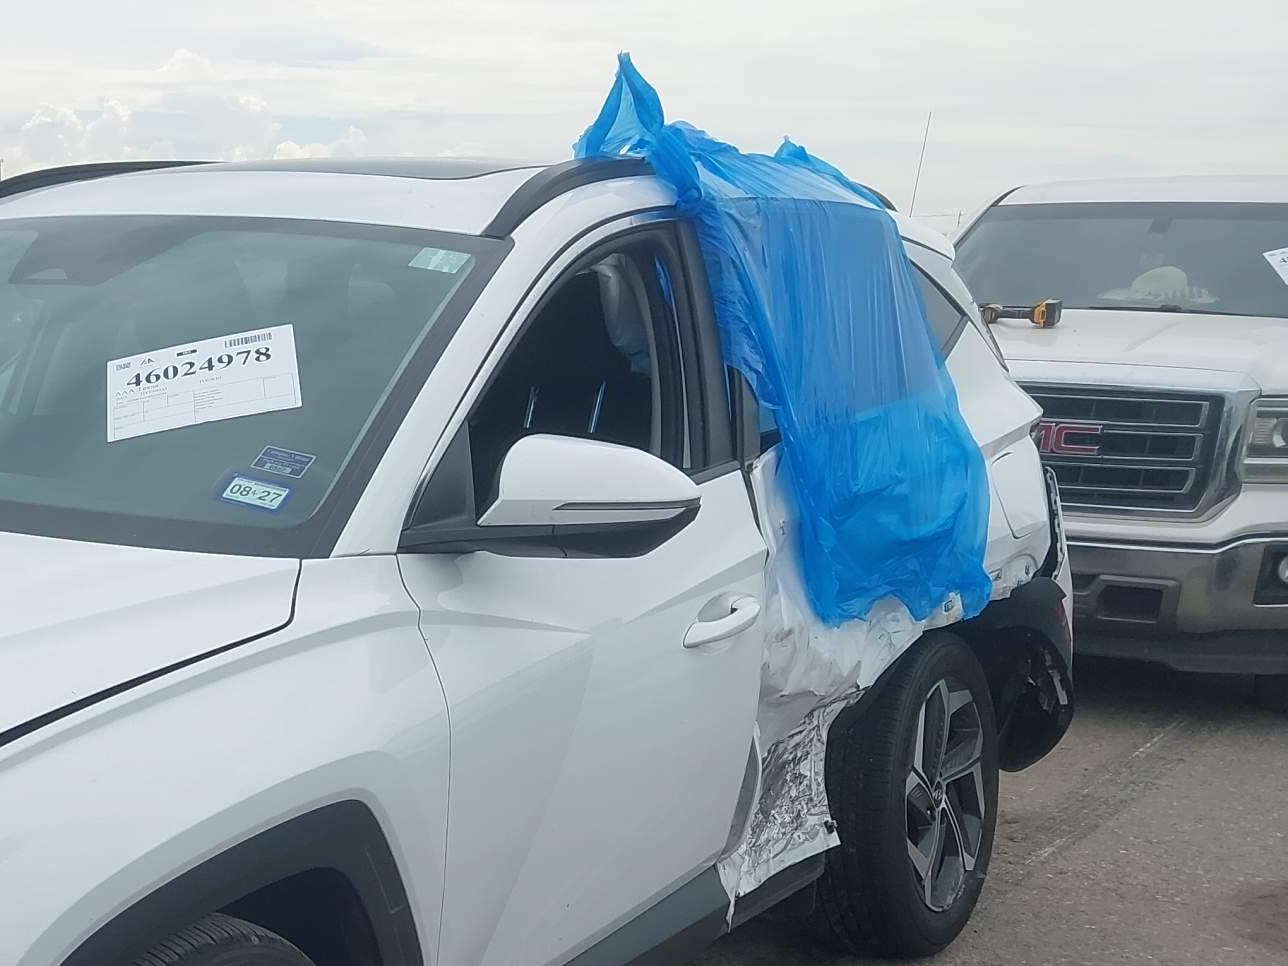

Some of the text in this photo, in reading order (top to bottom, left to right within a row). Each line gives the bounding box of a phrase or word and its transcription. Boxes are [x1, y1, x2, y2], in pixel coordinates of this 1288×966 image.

[126, 346, 272, 388] 46024978
[230, 484, 252, 497] 08
[257, 490, 282, 502] 27
